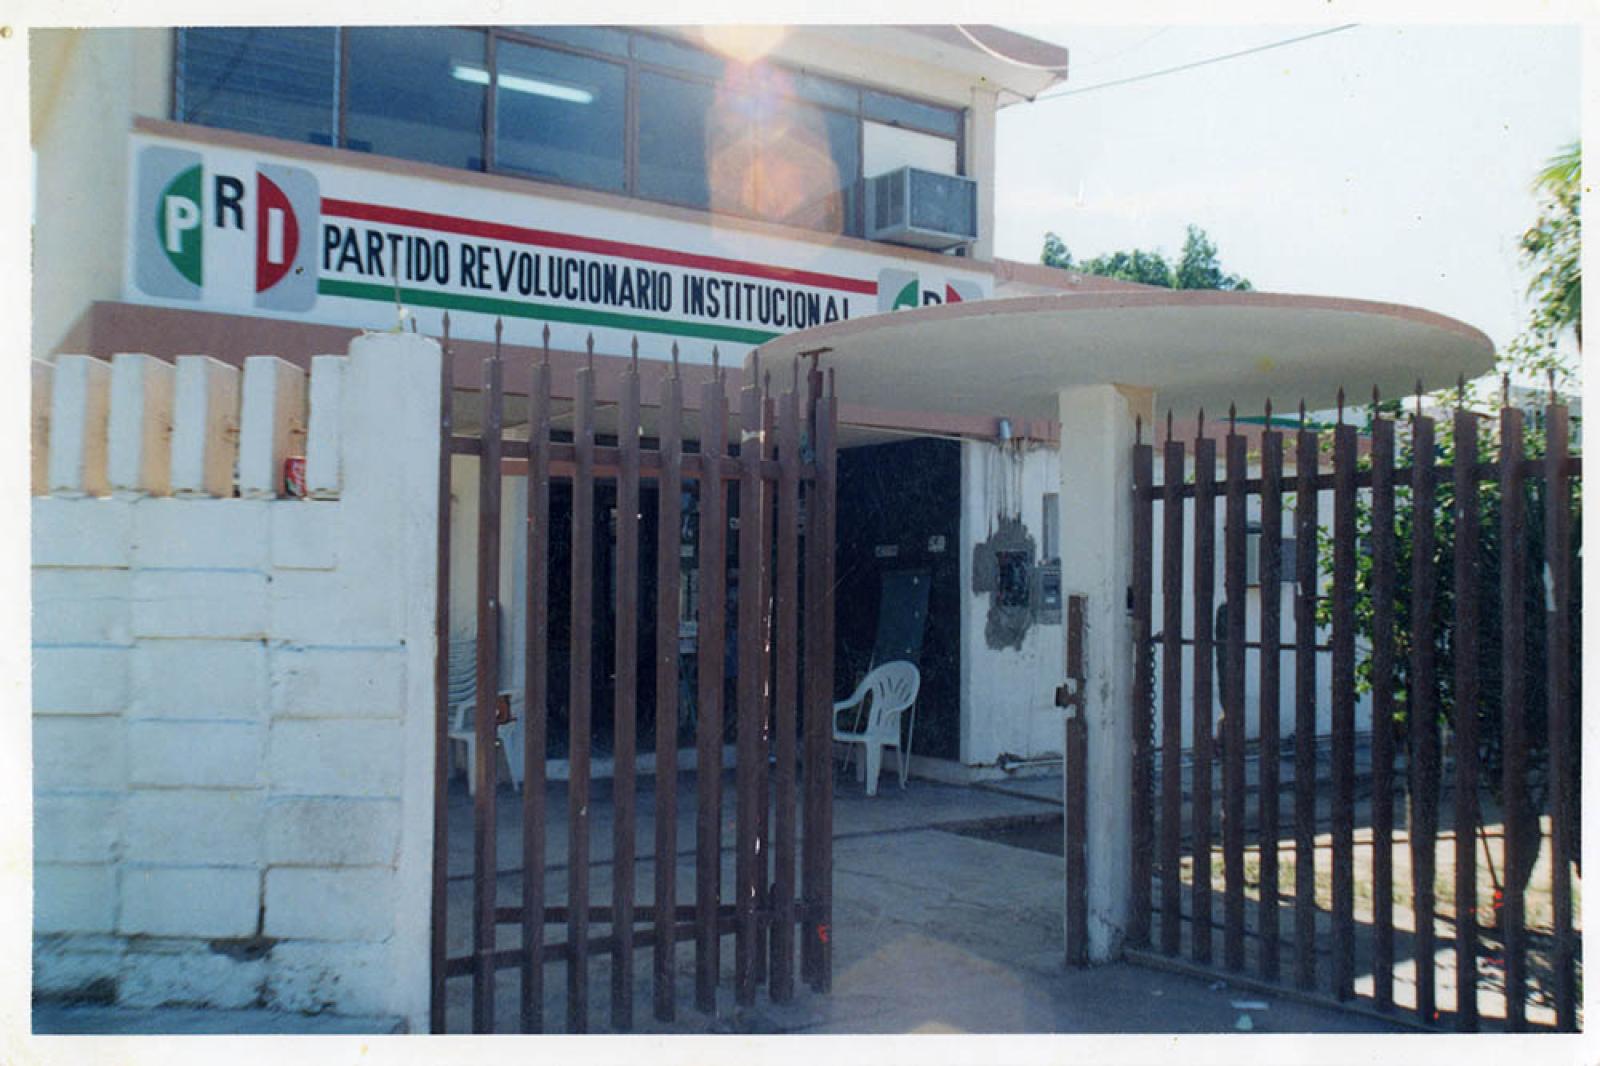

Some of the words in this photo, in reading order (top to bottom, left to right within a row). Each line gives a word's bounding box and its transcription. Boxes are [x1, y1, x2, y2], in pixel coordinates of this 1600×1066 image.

[164, 175, 285, 265] PRI
[323, 224, 449, 285] PARTIDO
[461, 243, 672, 312] REVOLUCIONARIO
